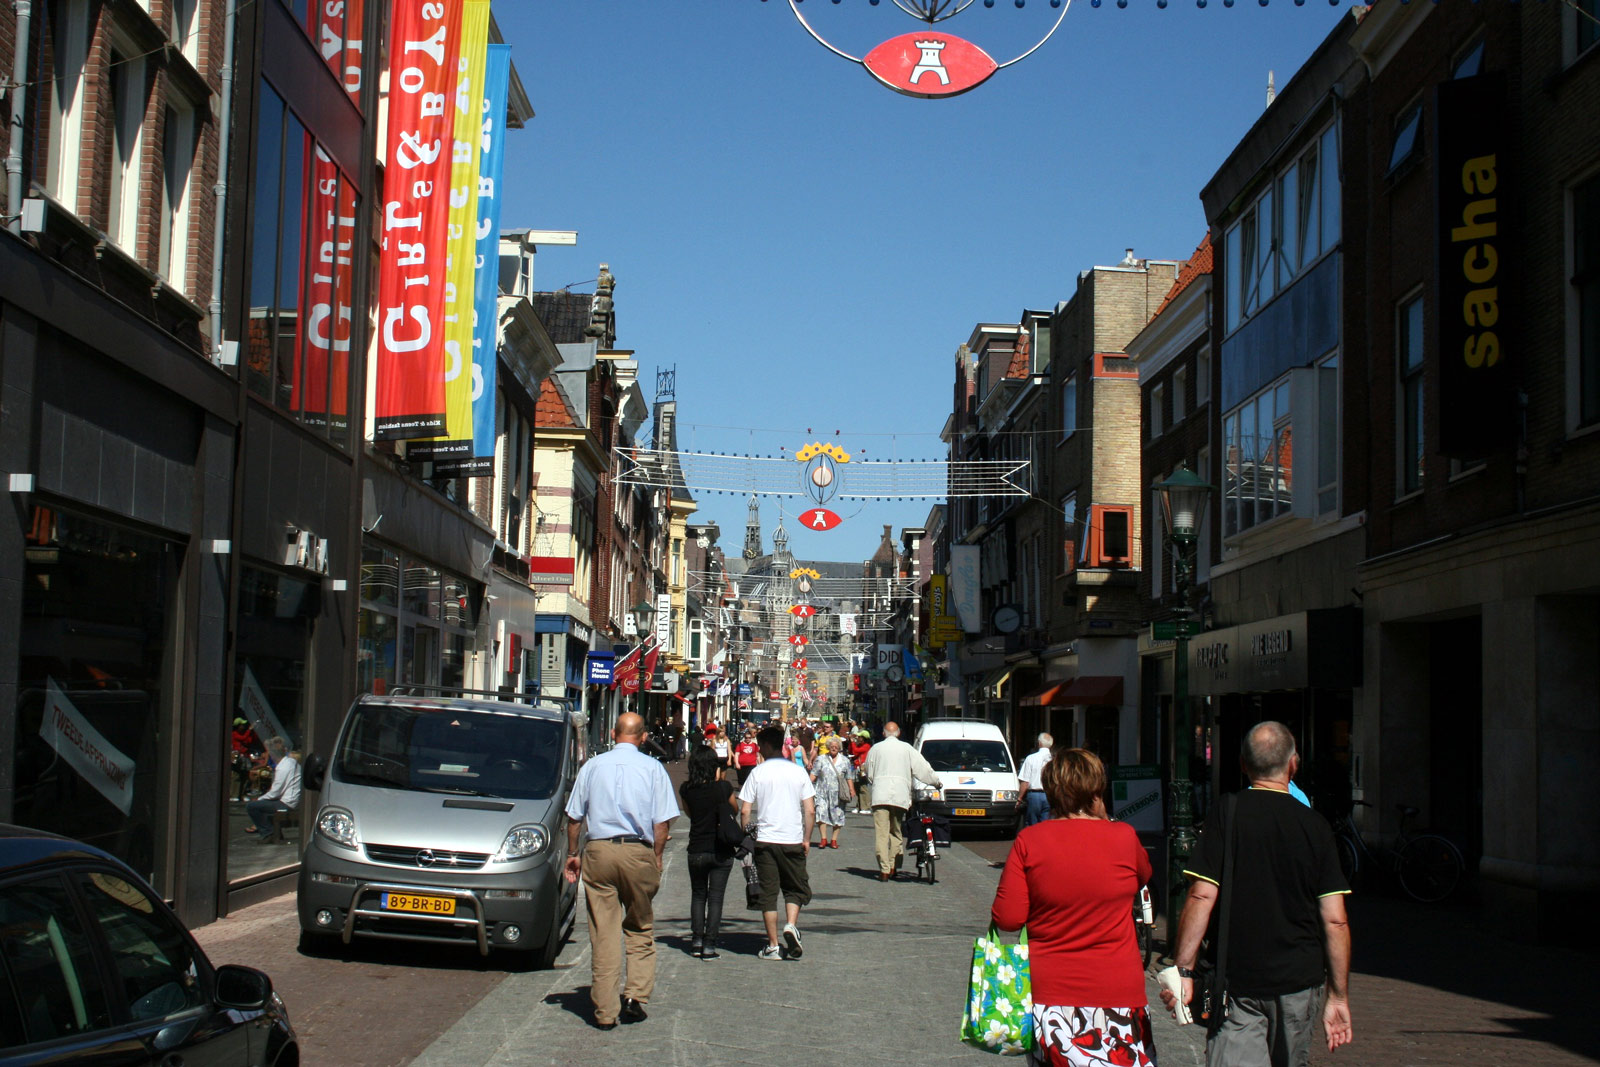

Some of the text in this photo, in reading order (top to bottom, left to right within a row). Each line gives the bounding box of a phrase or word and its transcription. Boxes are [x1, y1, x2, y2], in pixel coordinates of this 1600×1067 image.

[322, 0, 363, 93] OYS
[1450, 152, 1500, 369] sacha
[52, 704, 84, 752] TWEEDE
[390, 896, 452, 912] 89-BR-BD
